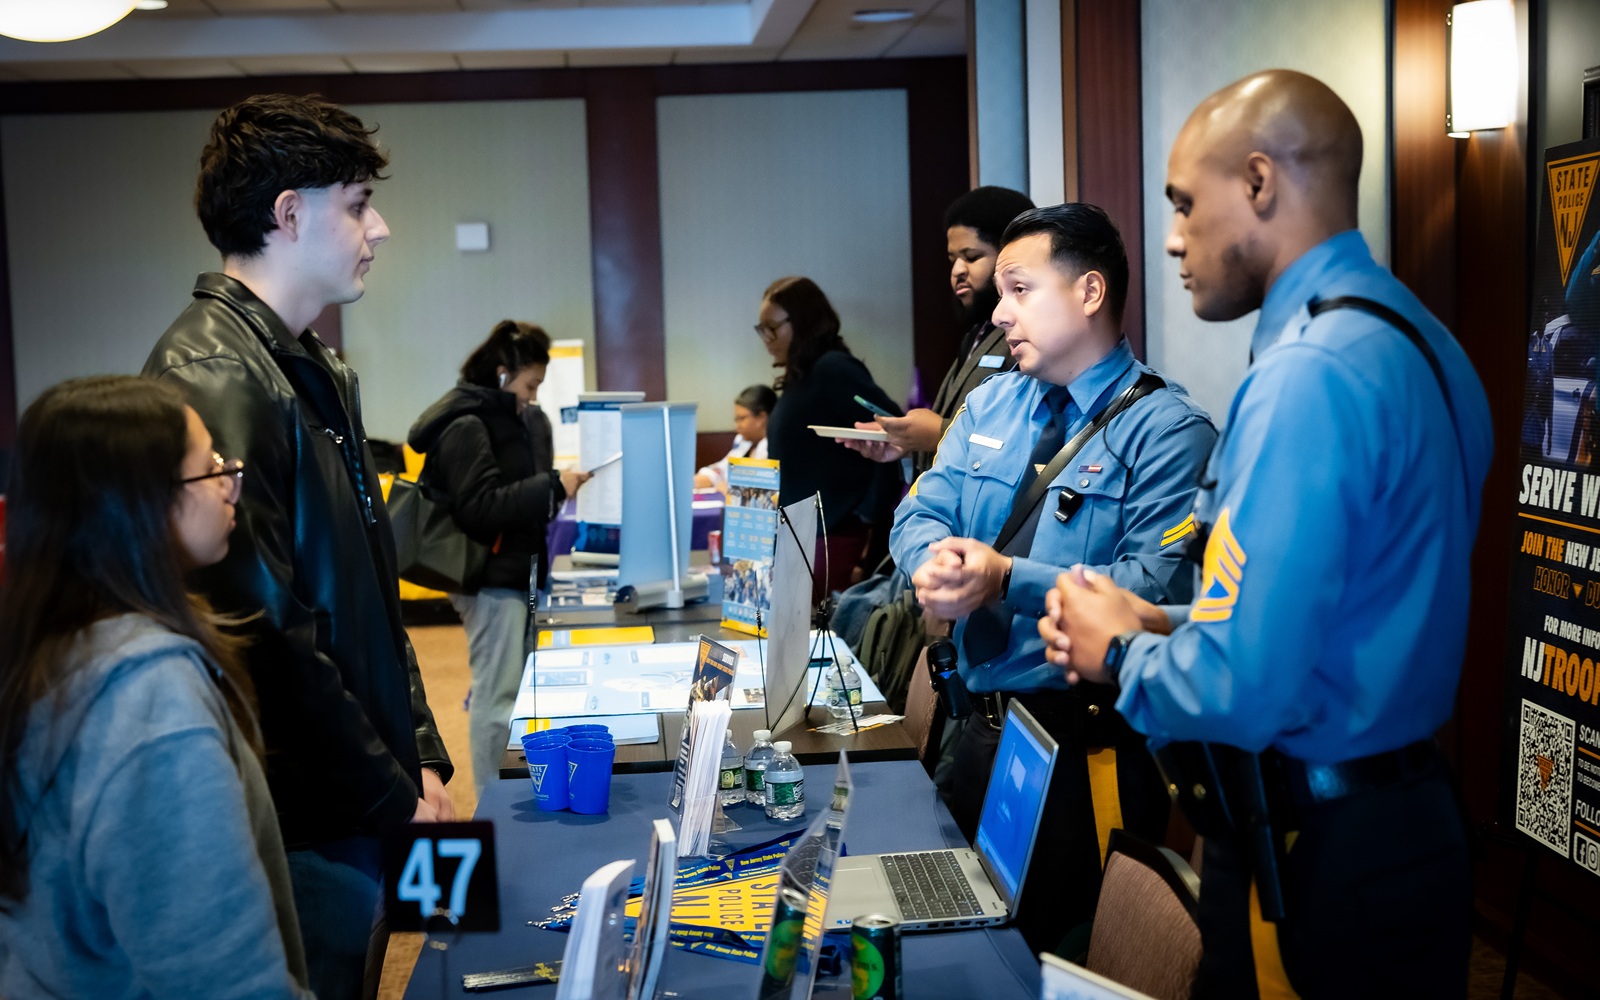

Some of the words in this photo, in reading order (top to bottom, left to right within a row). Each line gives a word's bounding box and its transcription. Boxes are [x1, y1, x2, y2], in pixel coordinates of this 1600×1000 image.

[1556, 166, 1590, 192] STATE
[1558, 193, 1584, 209] POLICE
[1560, 211, 1578, 248] NJ
[1518, 464, 1577, 513] SERVE
[1580, 473, 1600, 518] W
[1521, 531, 1544, 556] JOIN
[1546, 536, 1565, 562] THE
[1565, 541, 1590, 568] NEW
[1533, 566, 1571, 599] HONOR
[1544, 615, 1559, 635] FOR
[1559, 620, 1582, 643] MORE
[397, 838, 481, 918] 47
[718, 889, 744, 926] POLICE
